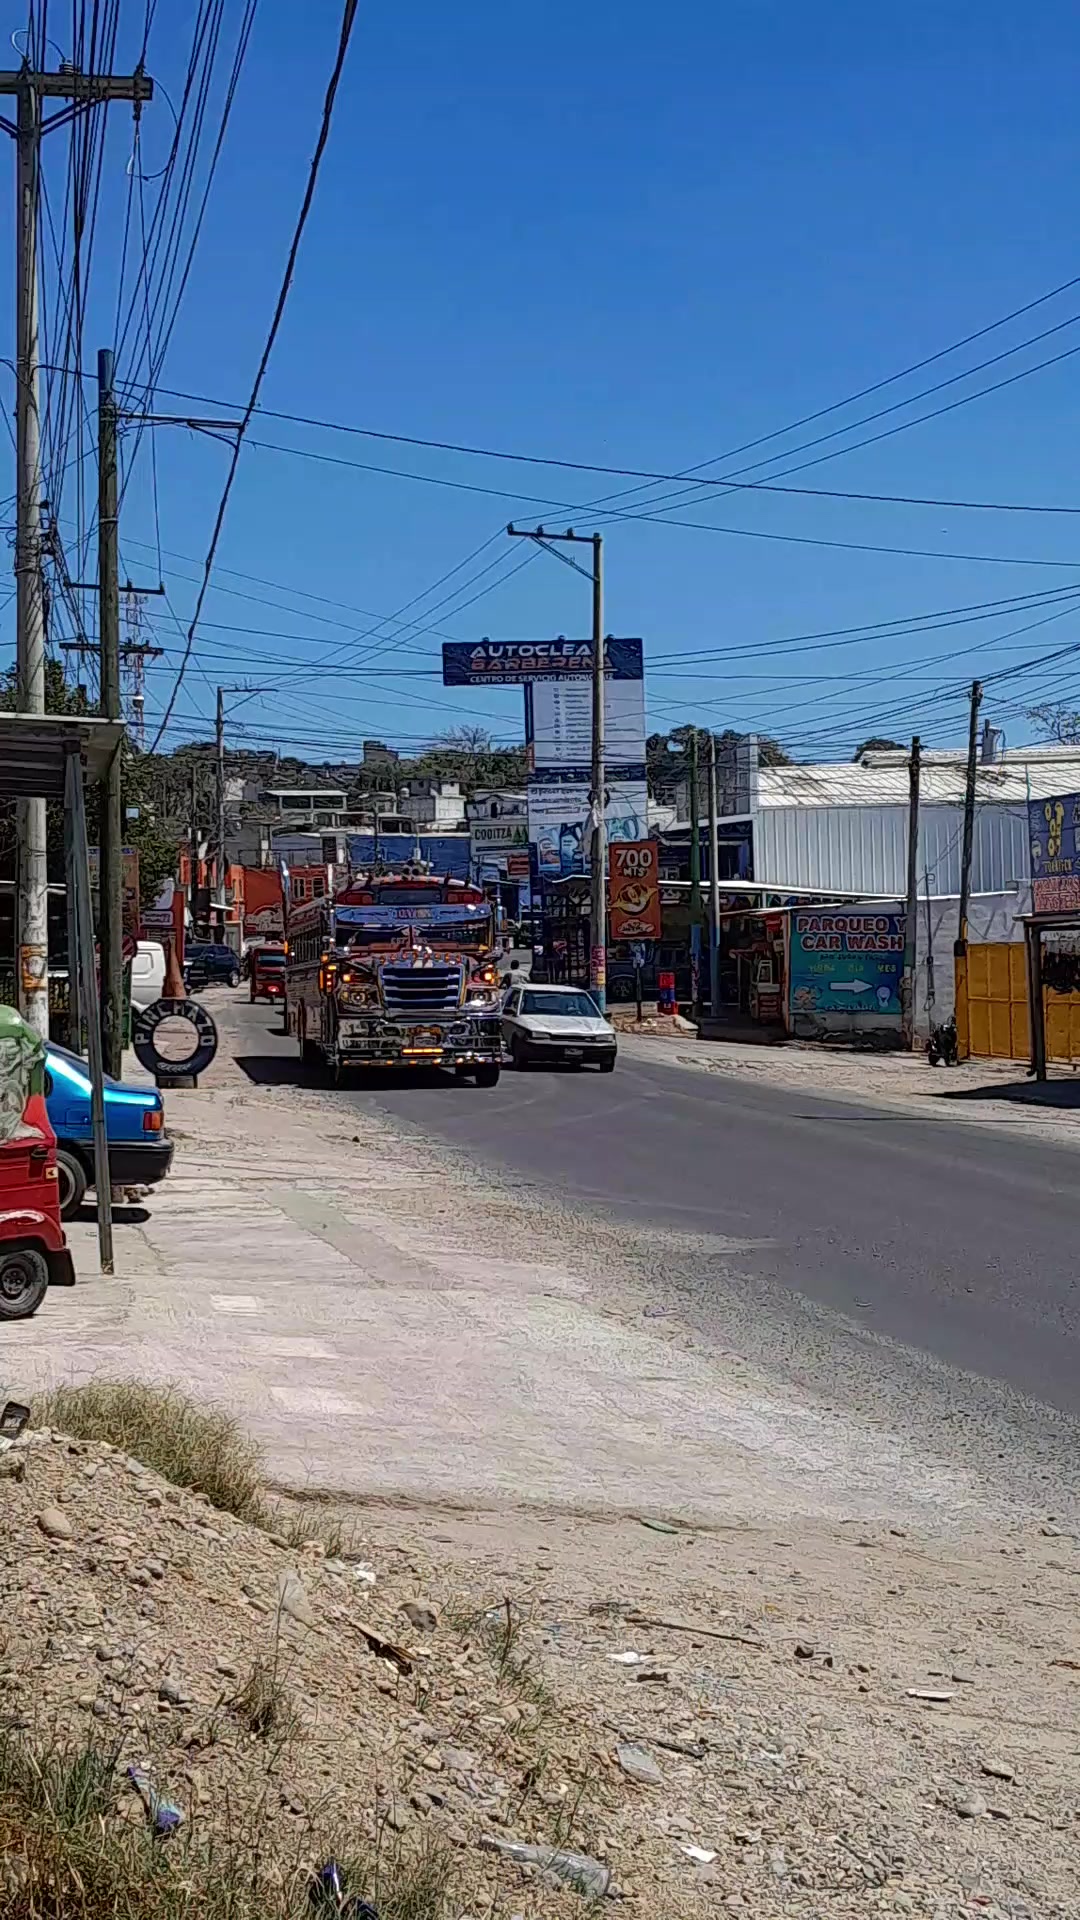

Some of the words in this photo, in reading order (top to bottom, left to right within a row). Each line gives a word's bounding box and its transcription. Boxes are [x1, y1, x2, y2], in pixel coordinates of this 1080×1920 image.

[470, 643, 608, 658] AUTOCLEA
[470, 674, 503, 683] CENTRO
[504, 674, 517, 683] DE
[518, 674, 556, 682] SERVICIO
[615, 848, 653, 867] 700
[623, 867, 645, 877] MTS
[797, 916, 889, 933] PARQUEO
[801, 934, 842, 951] CAR
[846, 934, 904, 951] WASH
[134, 1001, 215, 1047] PINCHAZO
